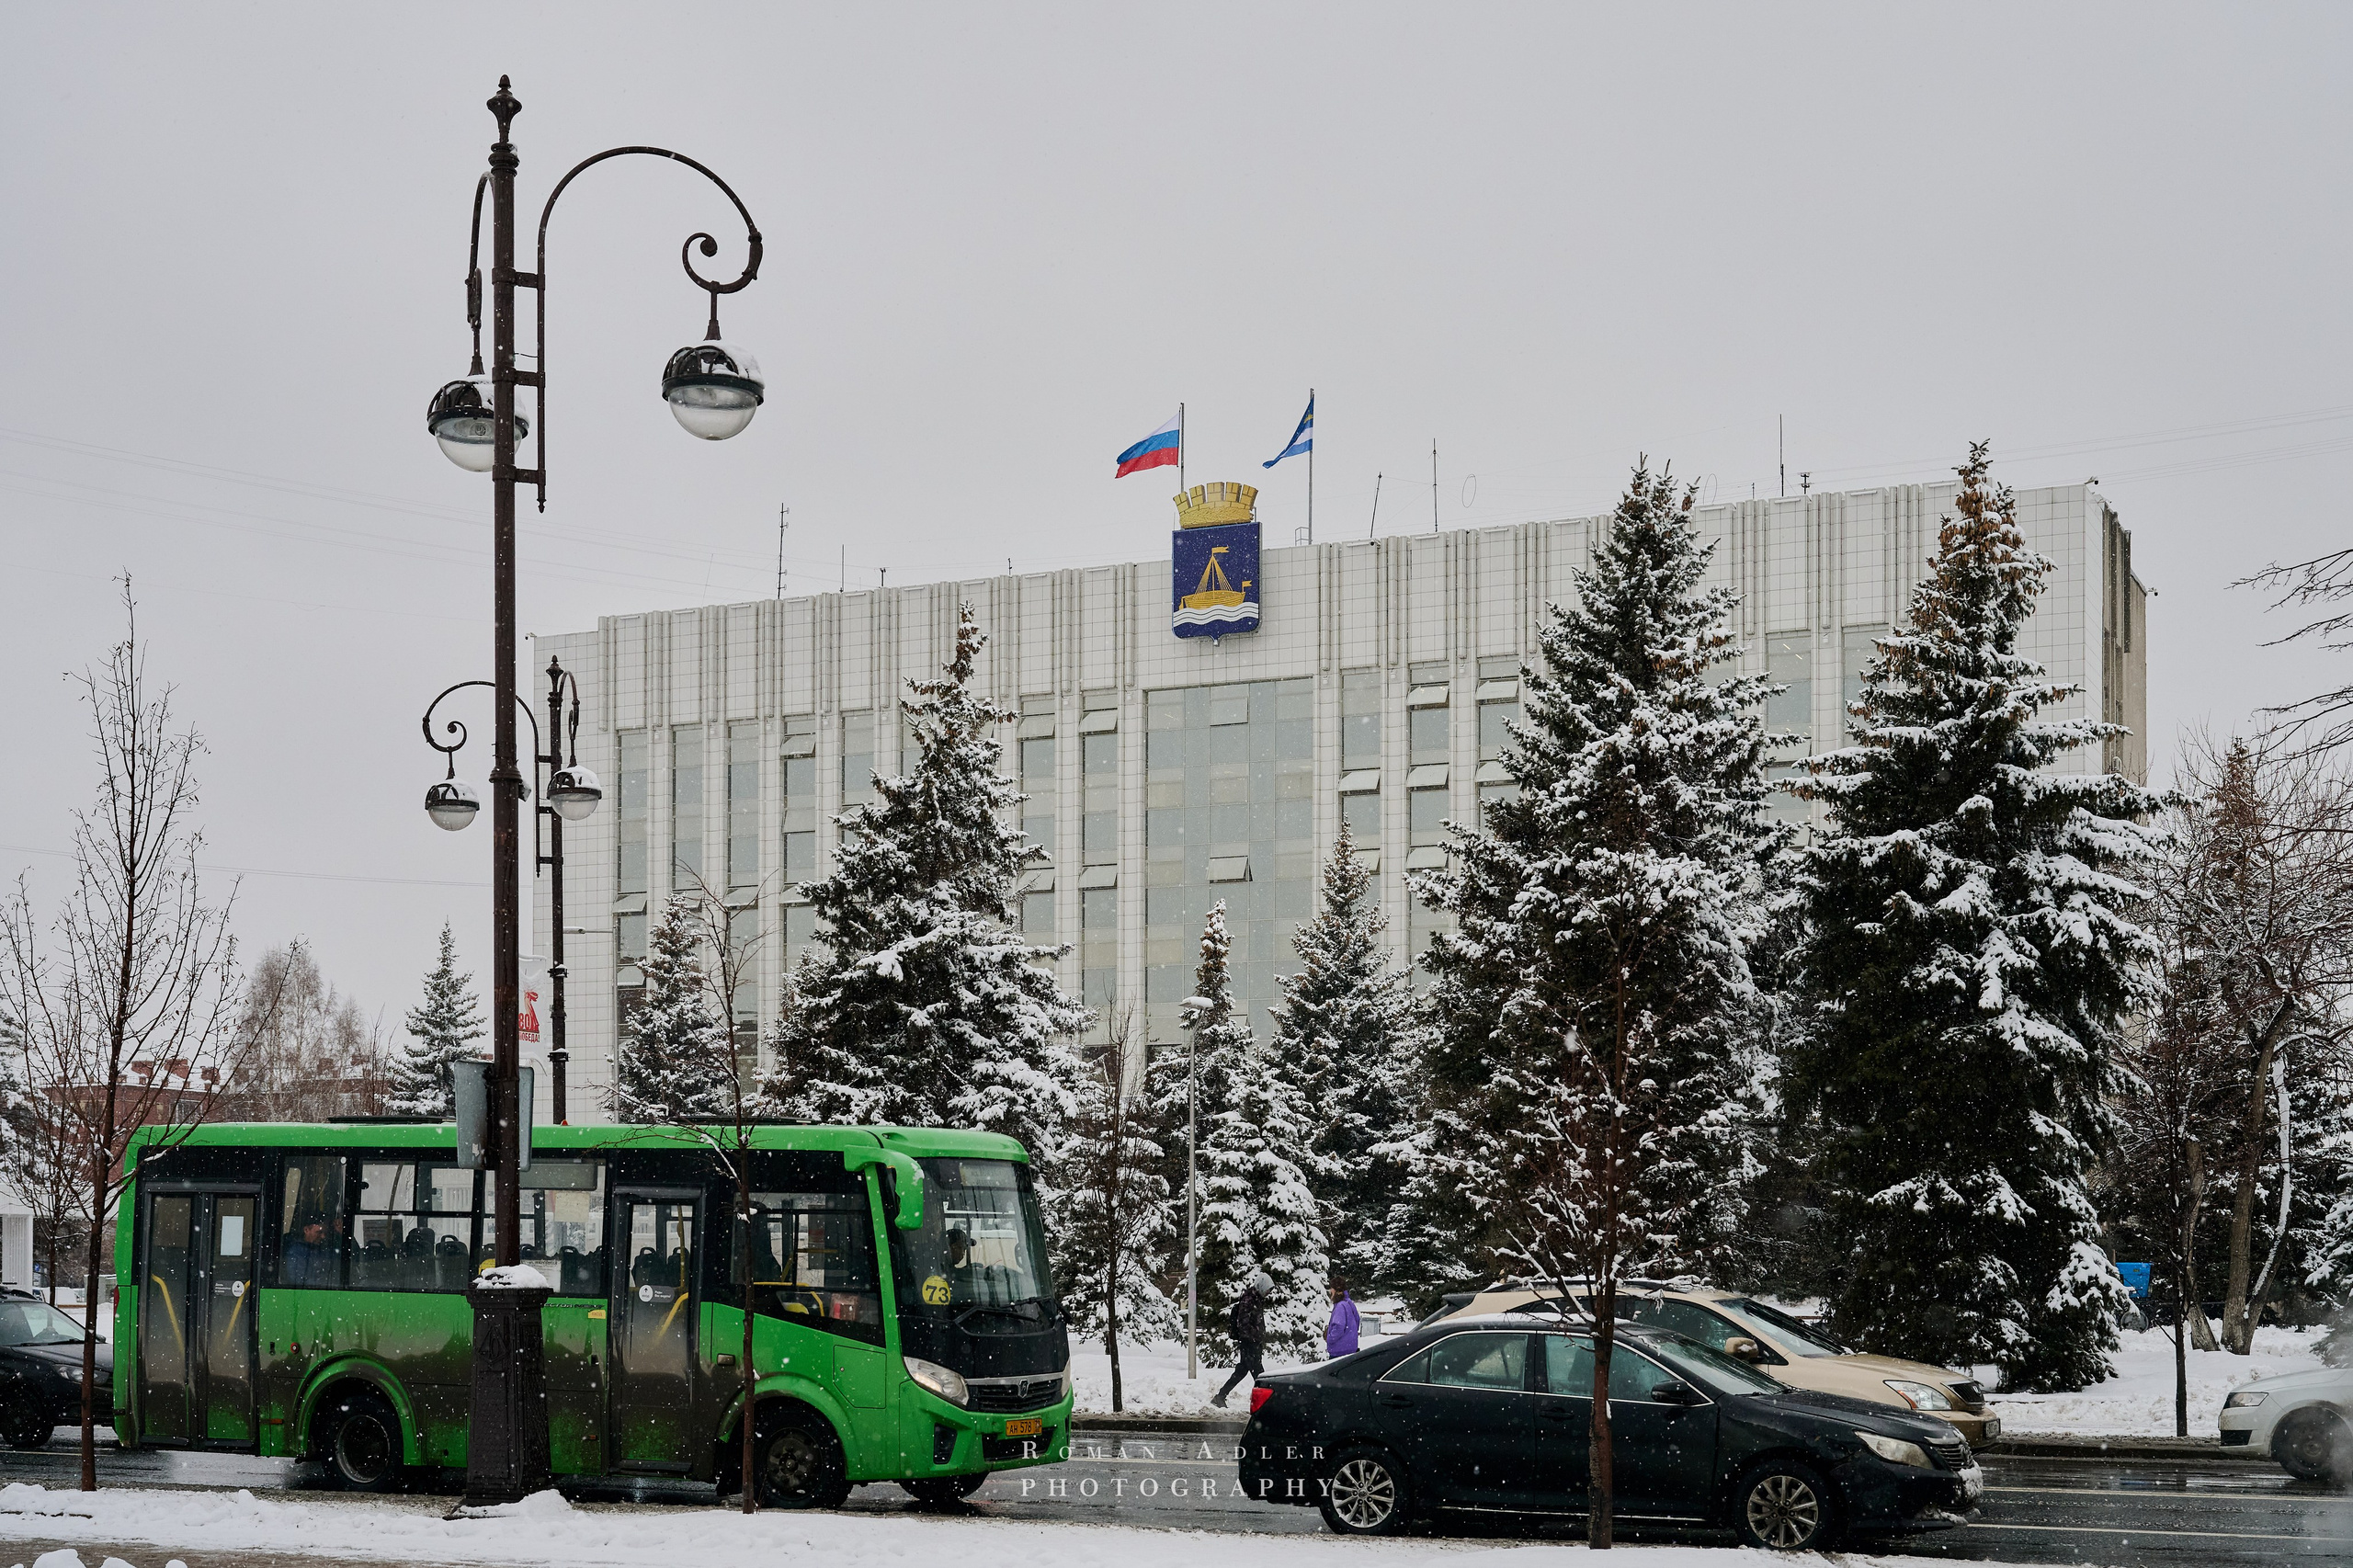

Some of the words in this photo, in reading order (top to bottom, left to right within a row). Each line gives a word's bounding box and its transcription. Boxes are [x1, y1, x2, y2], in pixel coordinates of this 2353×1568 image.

[518, 1013, 530, 1030] 80
[926, 1285, 949, 1303] 73
[1020, 1421, 1032, 1433] 578
